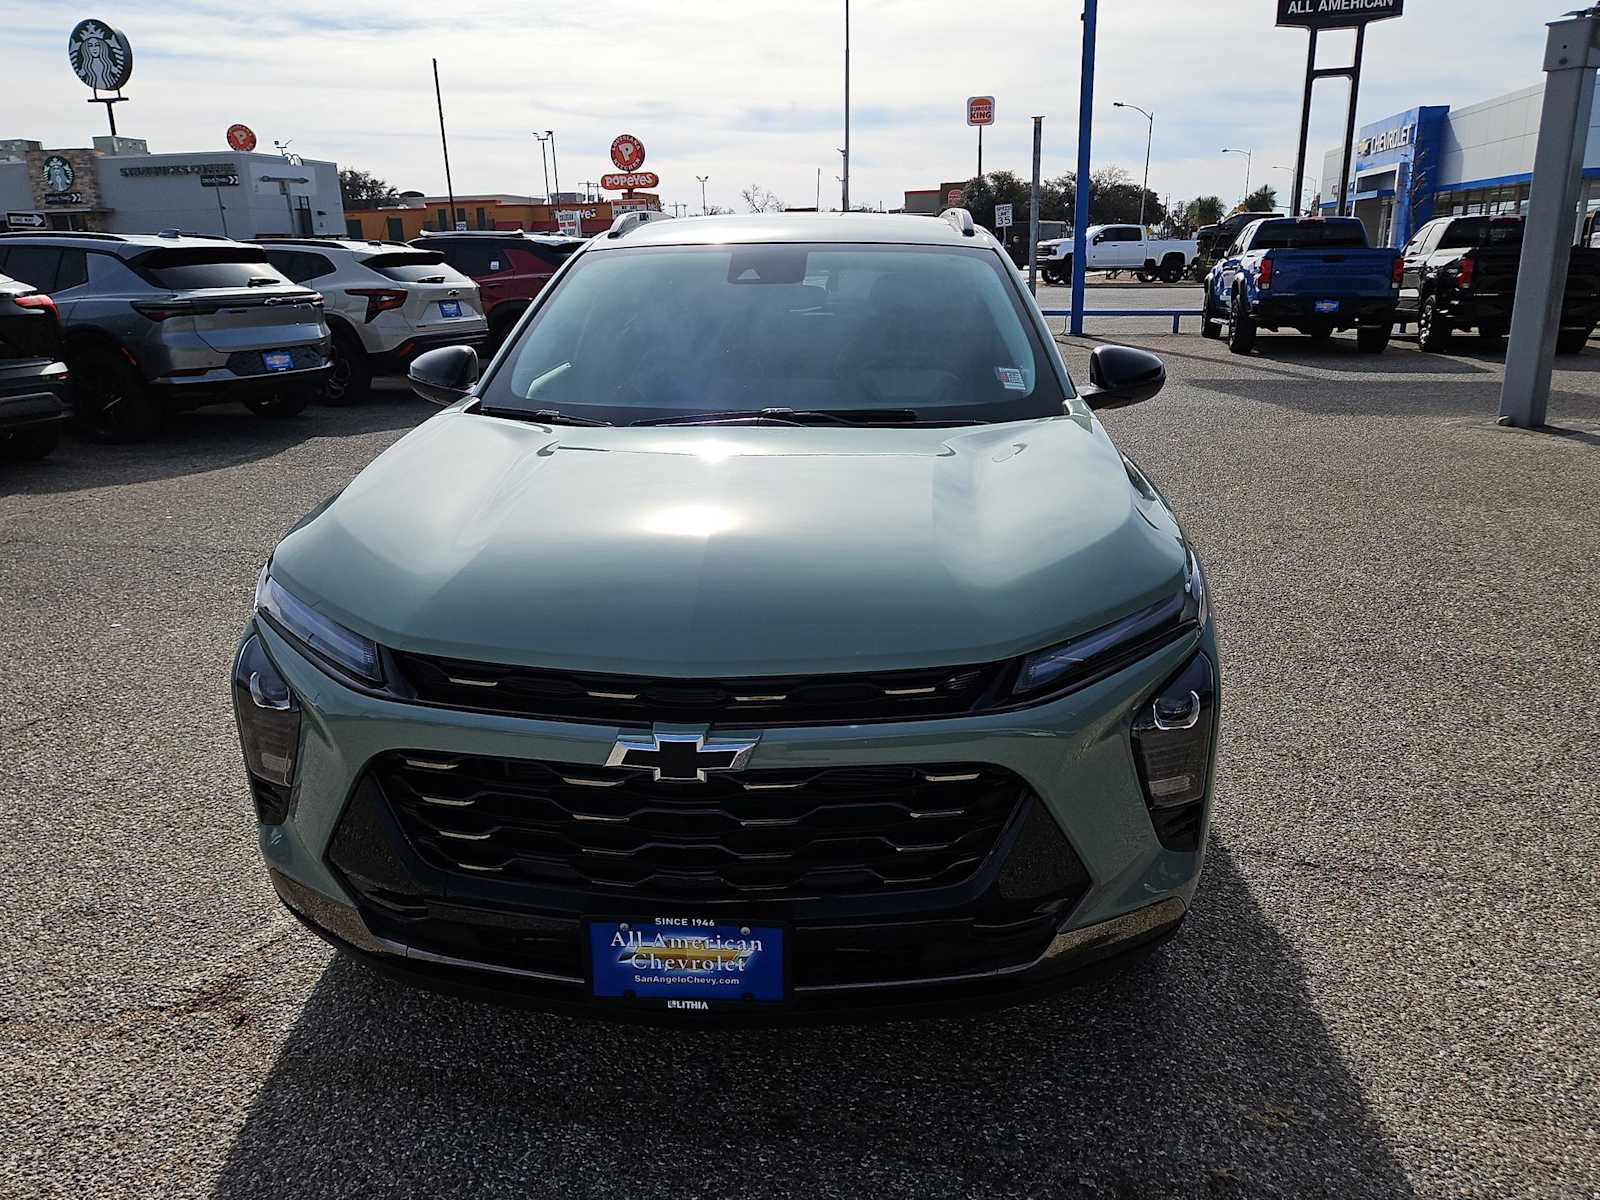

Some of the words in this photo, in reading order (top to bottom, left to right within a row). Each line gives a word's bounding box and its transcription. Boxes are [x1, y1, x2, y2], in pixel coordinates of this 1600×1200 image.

[1287, 0, 1314, 14] ALL
[970, 111, 992, 119] KING
[1370, 125, 1414, 153] CHEVROLET
[613, 157, 641, 170] KITCHEN
[997, 216, 1011, 225] 35
[655, 917, 688, 926] SINCE
[691, 918, 715, 927] 1946
[610, 930, 643, 948] All
[653, 932, 763, 952] American
[631, 953, 746, 972] Chevrolet
[634, 974, 740, 986] SanAngeloChevy.com
